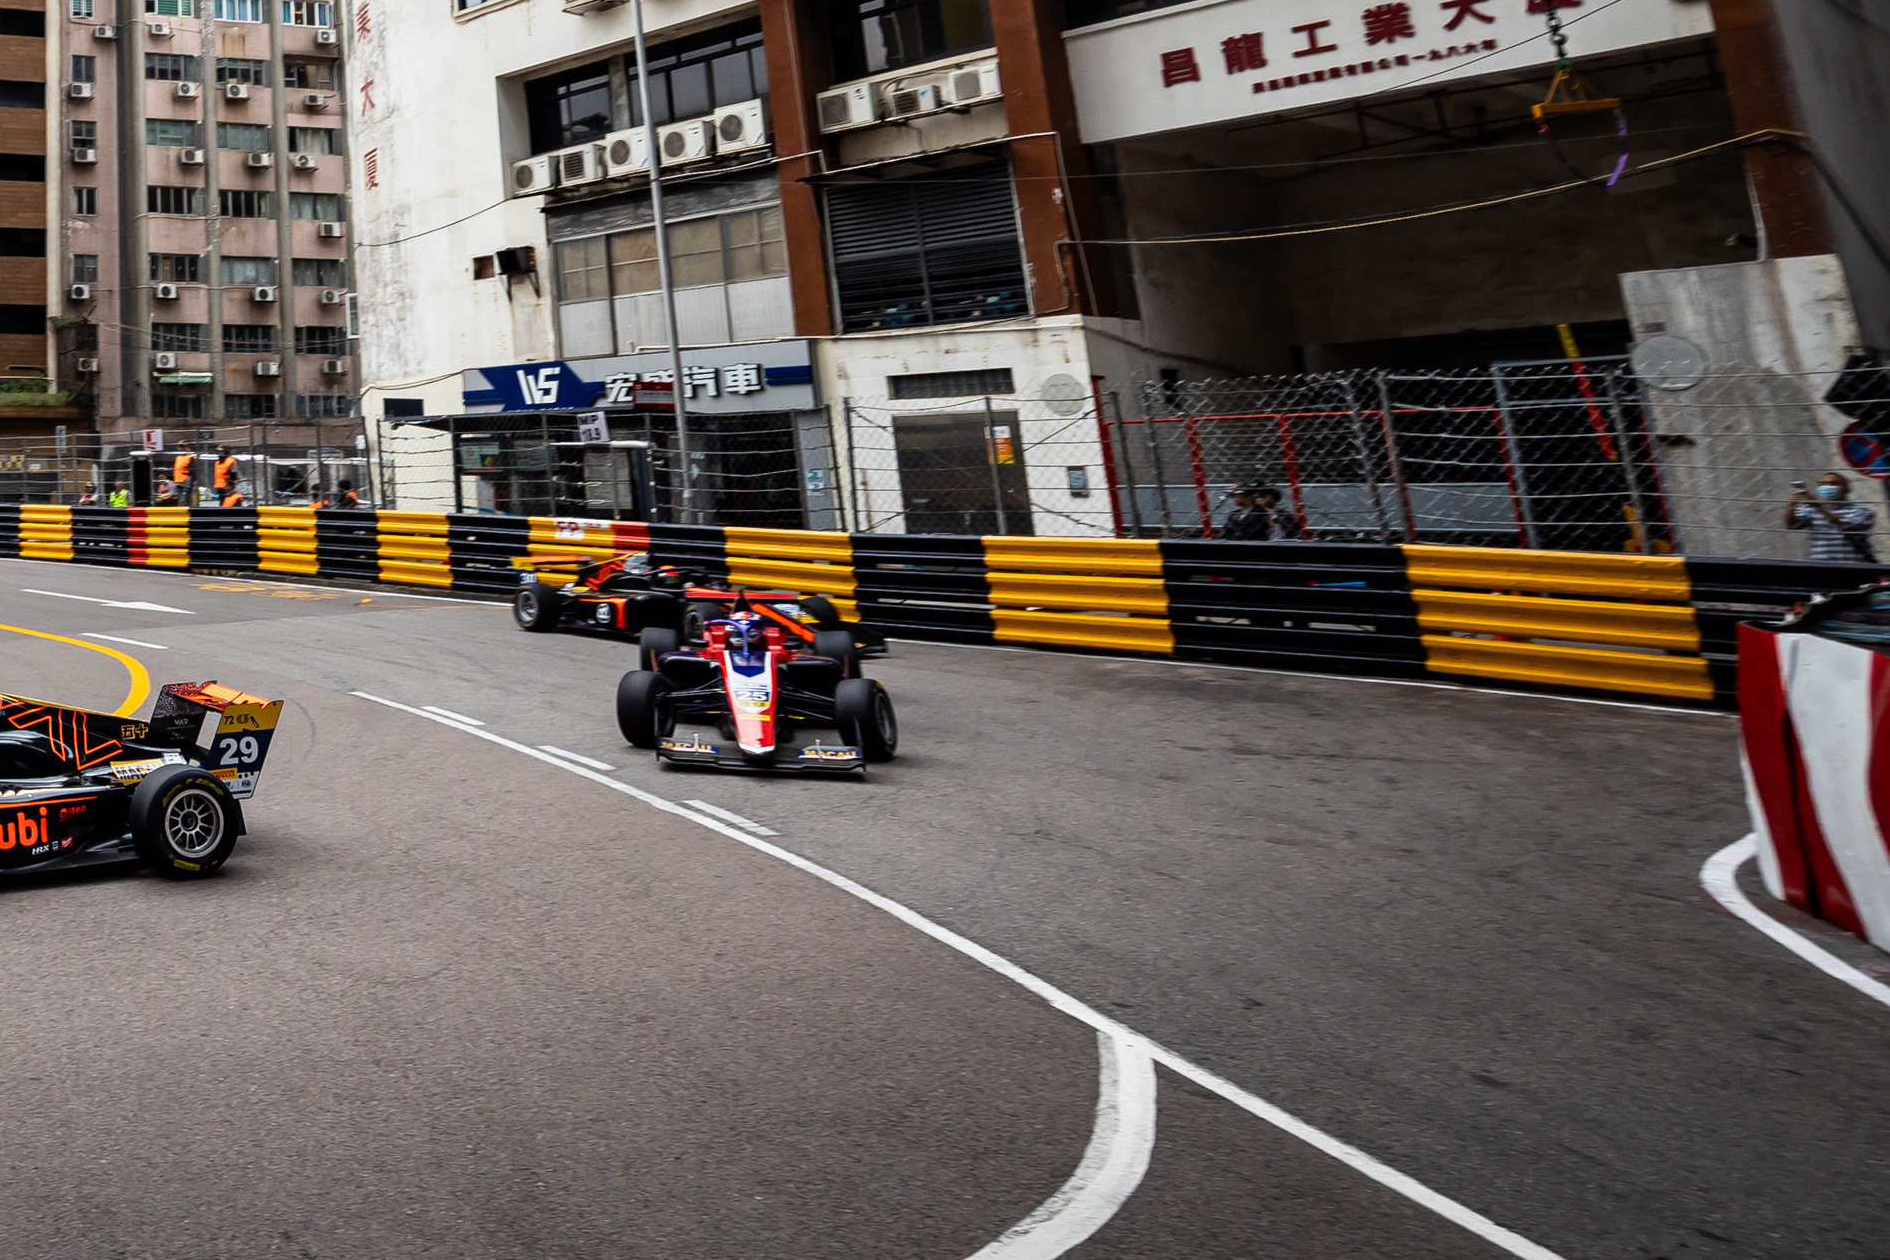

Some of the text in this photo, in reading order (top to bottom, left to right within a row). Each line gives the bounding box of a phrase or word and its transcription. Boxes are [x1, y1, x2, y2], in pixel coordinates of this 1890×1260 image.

[604, 363, 764, 404] 宏汽車
[736, 690, 768, 701] 25
[218, 736, 259, 766] 29
